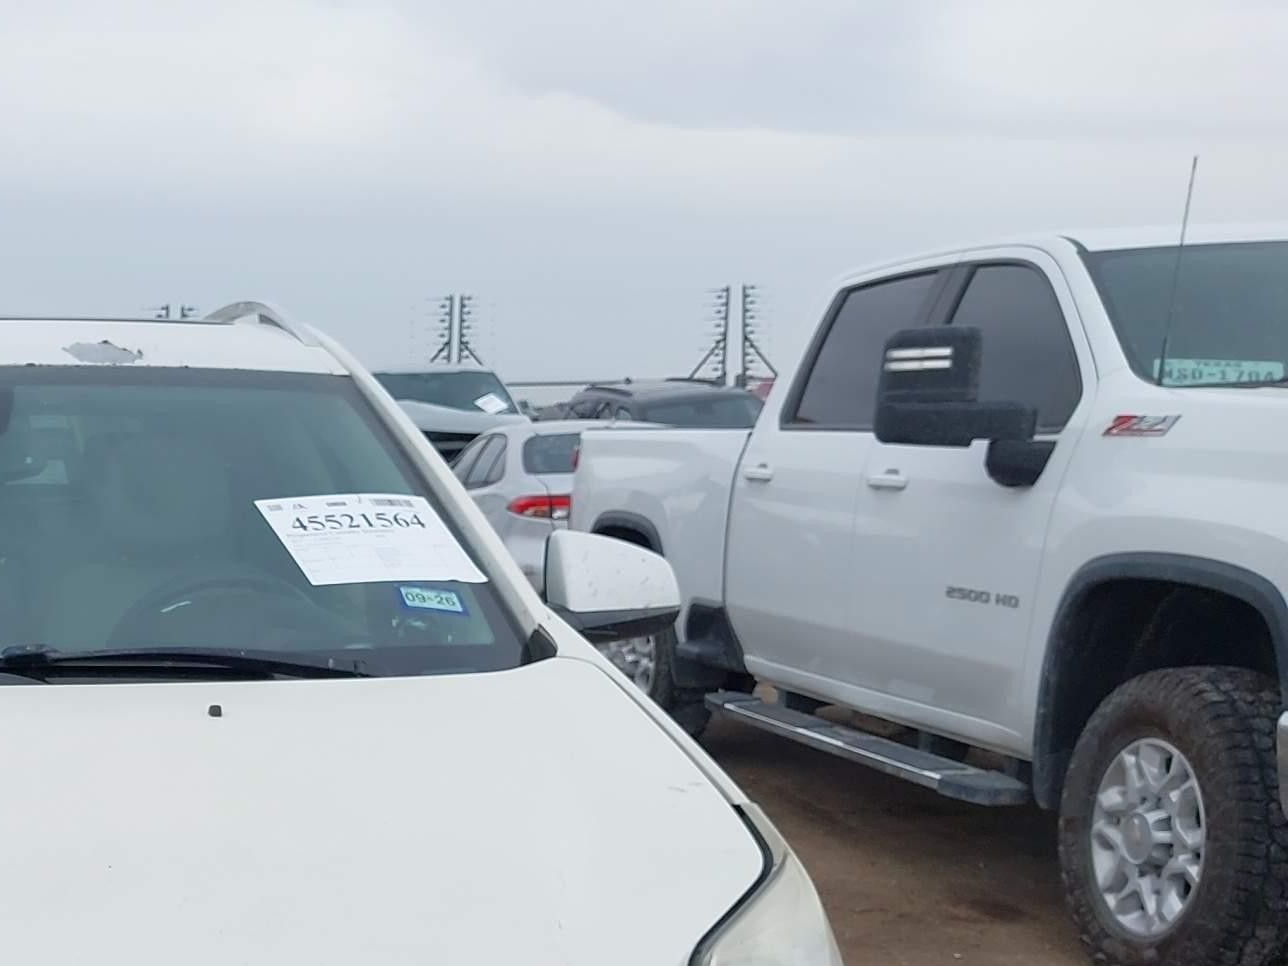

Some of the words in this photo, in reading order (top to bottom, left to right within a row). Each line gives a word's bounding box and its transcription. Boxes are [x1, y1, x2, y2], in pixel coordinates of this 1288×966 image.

[291, 511, 428, 533] 45521564
[945, 586, 991, 604] 2500
[995, 593, 1020, 608] HD
